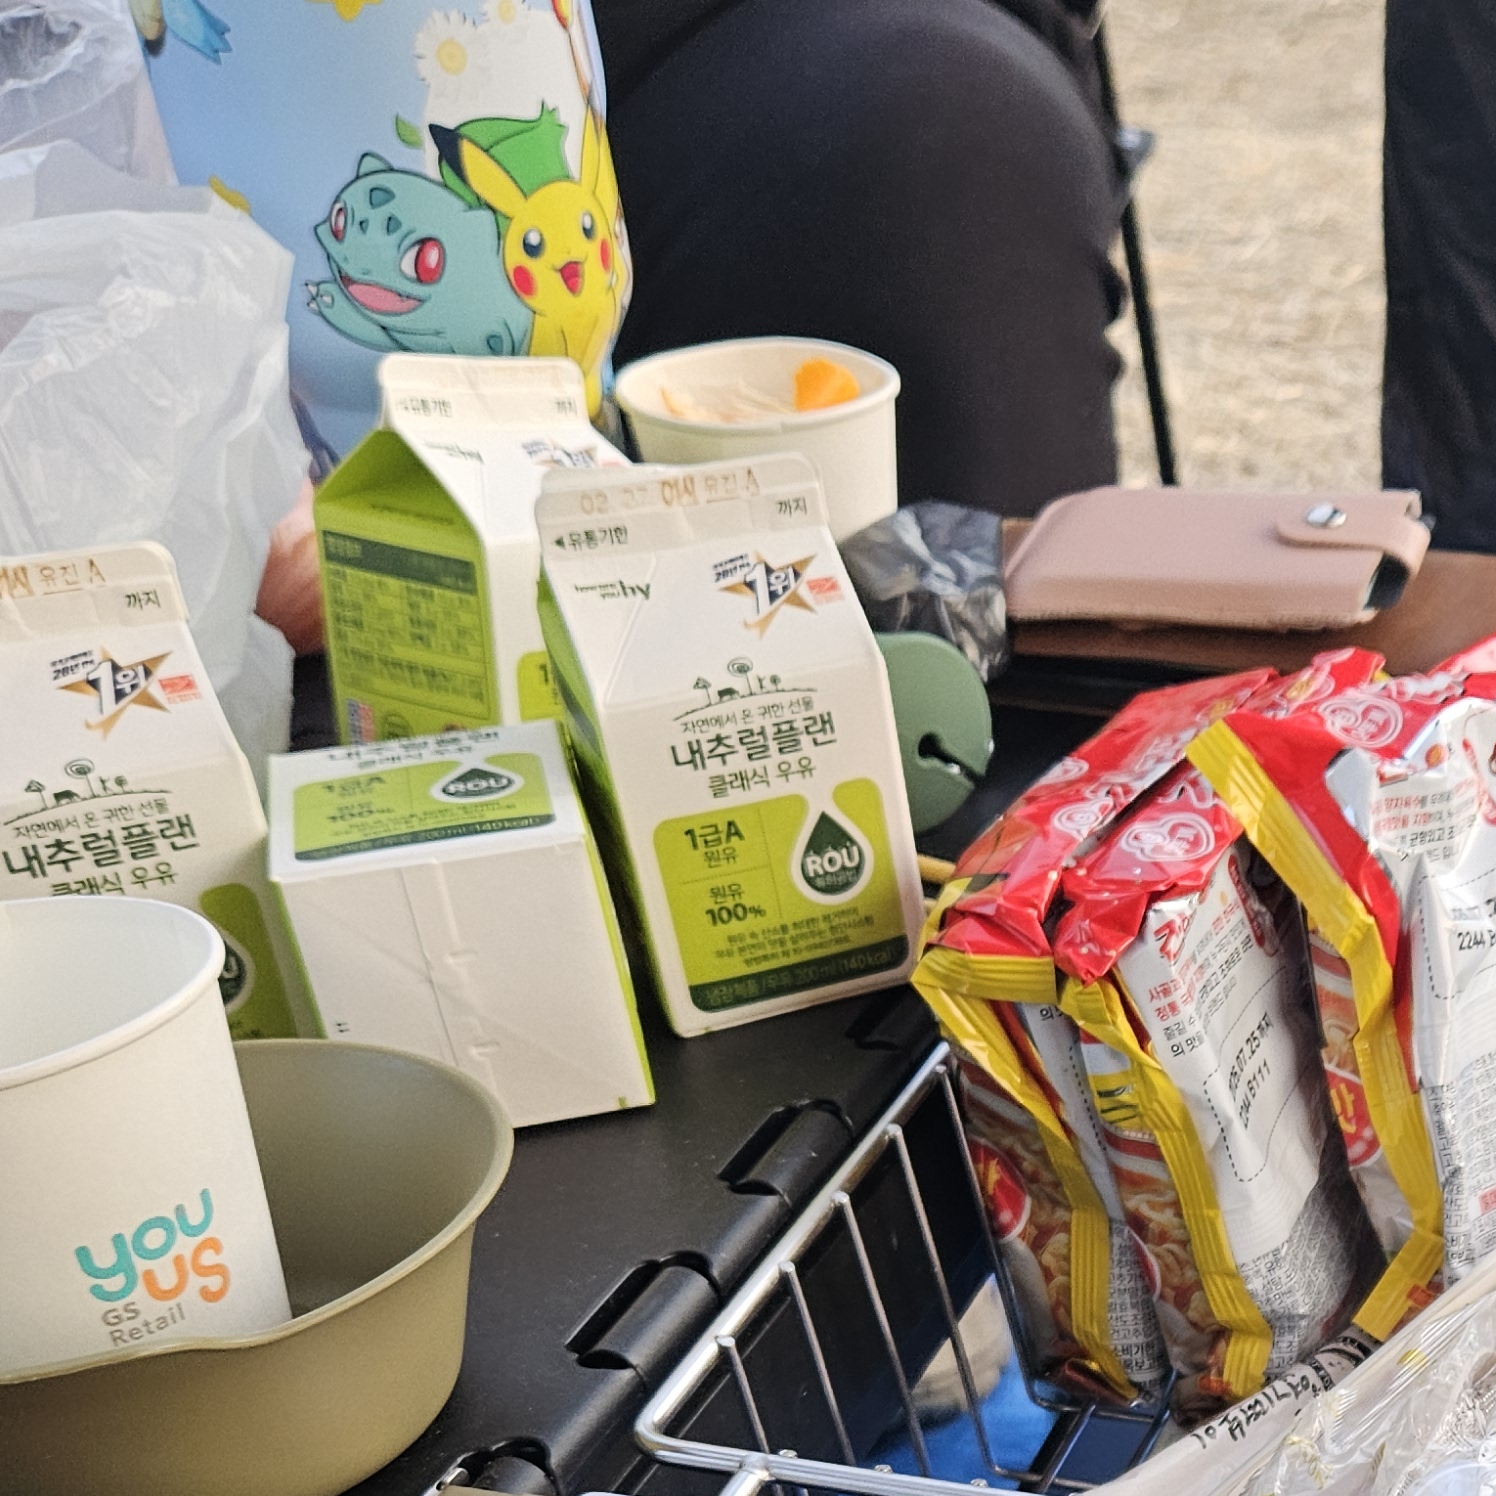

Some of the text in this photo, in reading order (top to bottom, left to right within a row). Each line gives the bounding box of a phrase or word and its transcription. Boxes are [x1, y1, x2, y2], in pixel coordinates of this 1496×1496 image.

[776, 497, 808, 518] 까지
[567, 525, 630, 551] 유통기한
[39, 562, 82, 587] 유진
[88, 558, 106, 584] A
[743, 560, 797, 615] 1위
[125, 589, 162, 610] 까지
[619, 579, 651, 602] hy
[86, 659, 148, 716] 1위
[680, 695, 815, 735] 자연에서 온 귀한 선물
[670, 711, 838, 772] 내추럴플랜
[708, 755, 817, 800] 클래식 우유
[13, 797, 171, 840] 자연에서 온 귀한 선물
[2, 813, 200, 879] 내추럴플랜
[683, 819, 746, 852] 1급A
[703, 846, 739, 870] 원유
[804, 844, 861, 879] ROU
[130, 860, 180, 890] 우유
[708, 882, 746, 905] 원유
[705, 902, 767, 927] 100%
[1171, 1043, 1186, 1059] 의
[74, 1188, 215, 1302] you
[141, 1236, 232, 1303] us
[100, 1302, 141, 1328] GS
[109, 1303, 187, 1347] Retail
